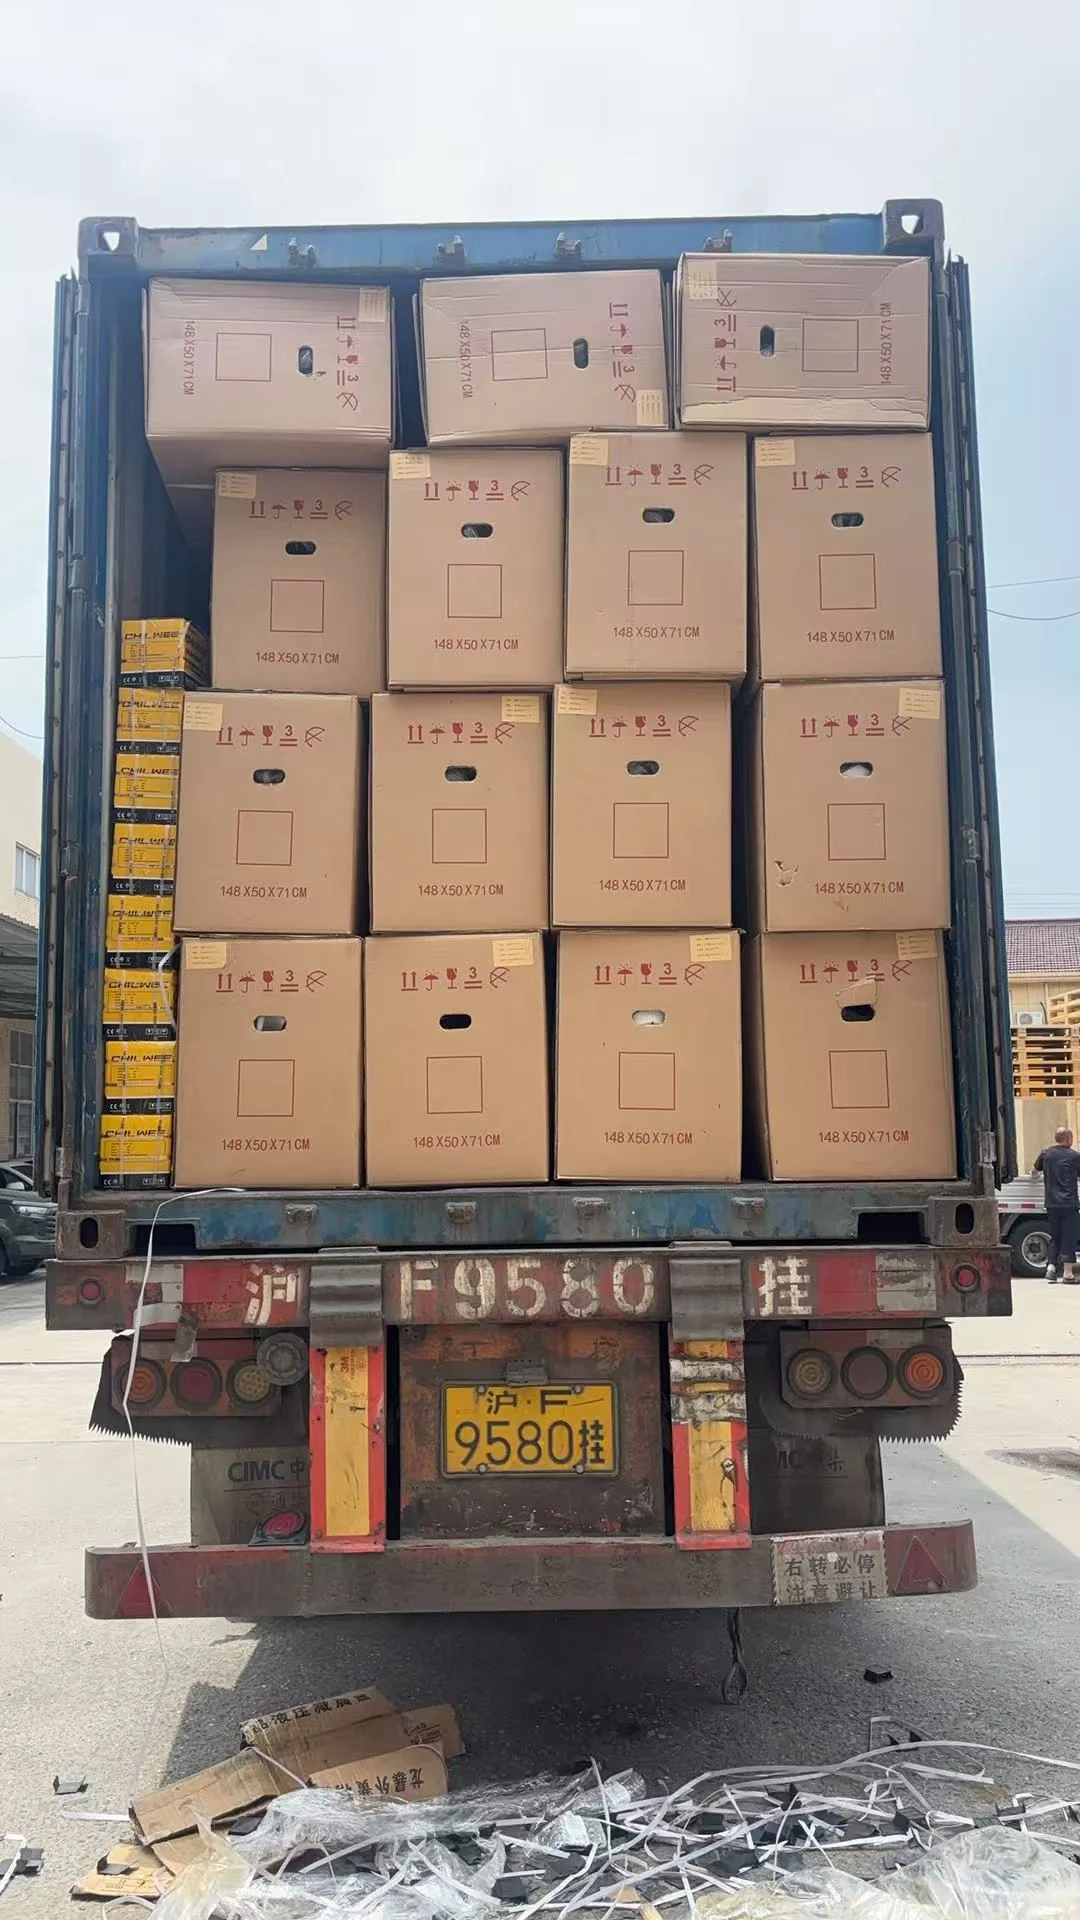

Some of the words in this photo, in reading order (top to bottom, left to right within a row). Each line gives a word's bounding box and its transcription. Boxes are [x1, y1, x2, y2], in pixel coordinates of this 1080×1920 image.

[672, 463, 682, 476] 3
[859, 465, 869, 479] 3
[490, 479, 500, 492] 3
[315, 499, 324, 511] 3
[125, 630, 179, 640] CHLWEE
[657, 714, 667, 728] 3
[870, 713, 880, 727] 3
[284, 724, 293, 737] 3
[474, 721, 484, 734] 3
[663, 962, 673, 976] 3
[870, 958, 880, 972] 3
[285, 969, 295, 983] 3
[468, 966, 478, 980] 3
[245, 1263, 297, 1326] 沪
[400, 1257, 654, 1320] F9580
[758, 1256, 813, 1317] 挂
[340, 1356, 349, 1373] 3M
[455, 1419, 605, 1466] 9580挂
[784, 1553, 876, 1577] 右转必停
